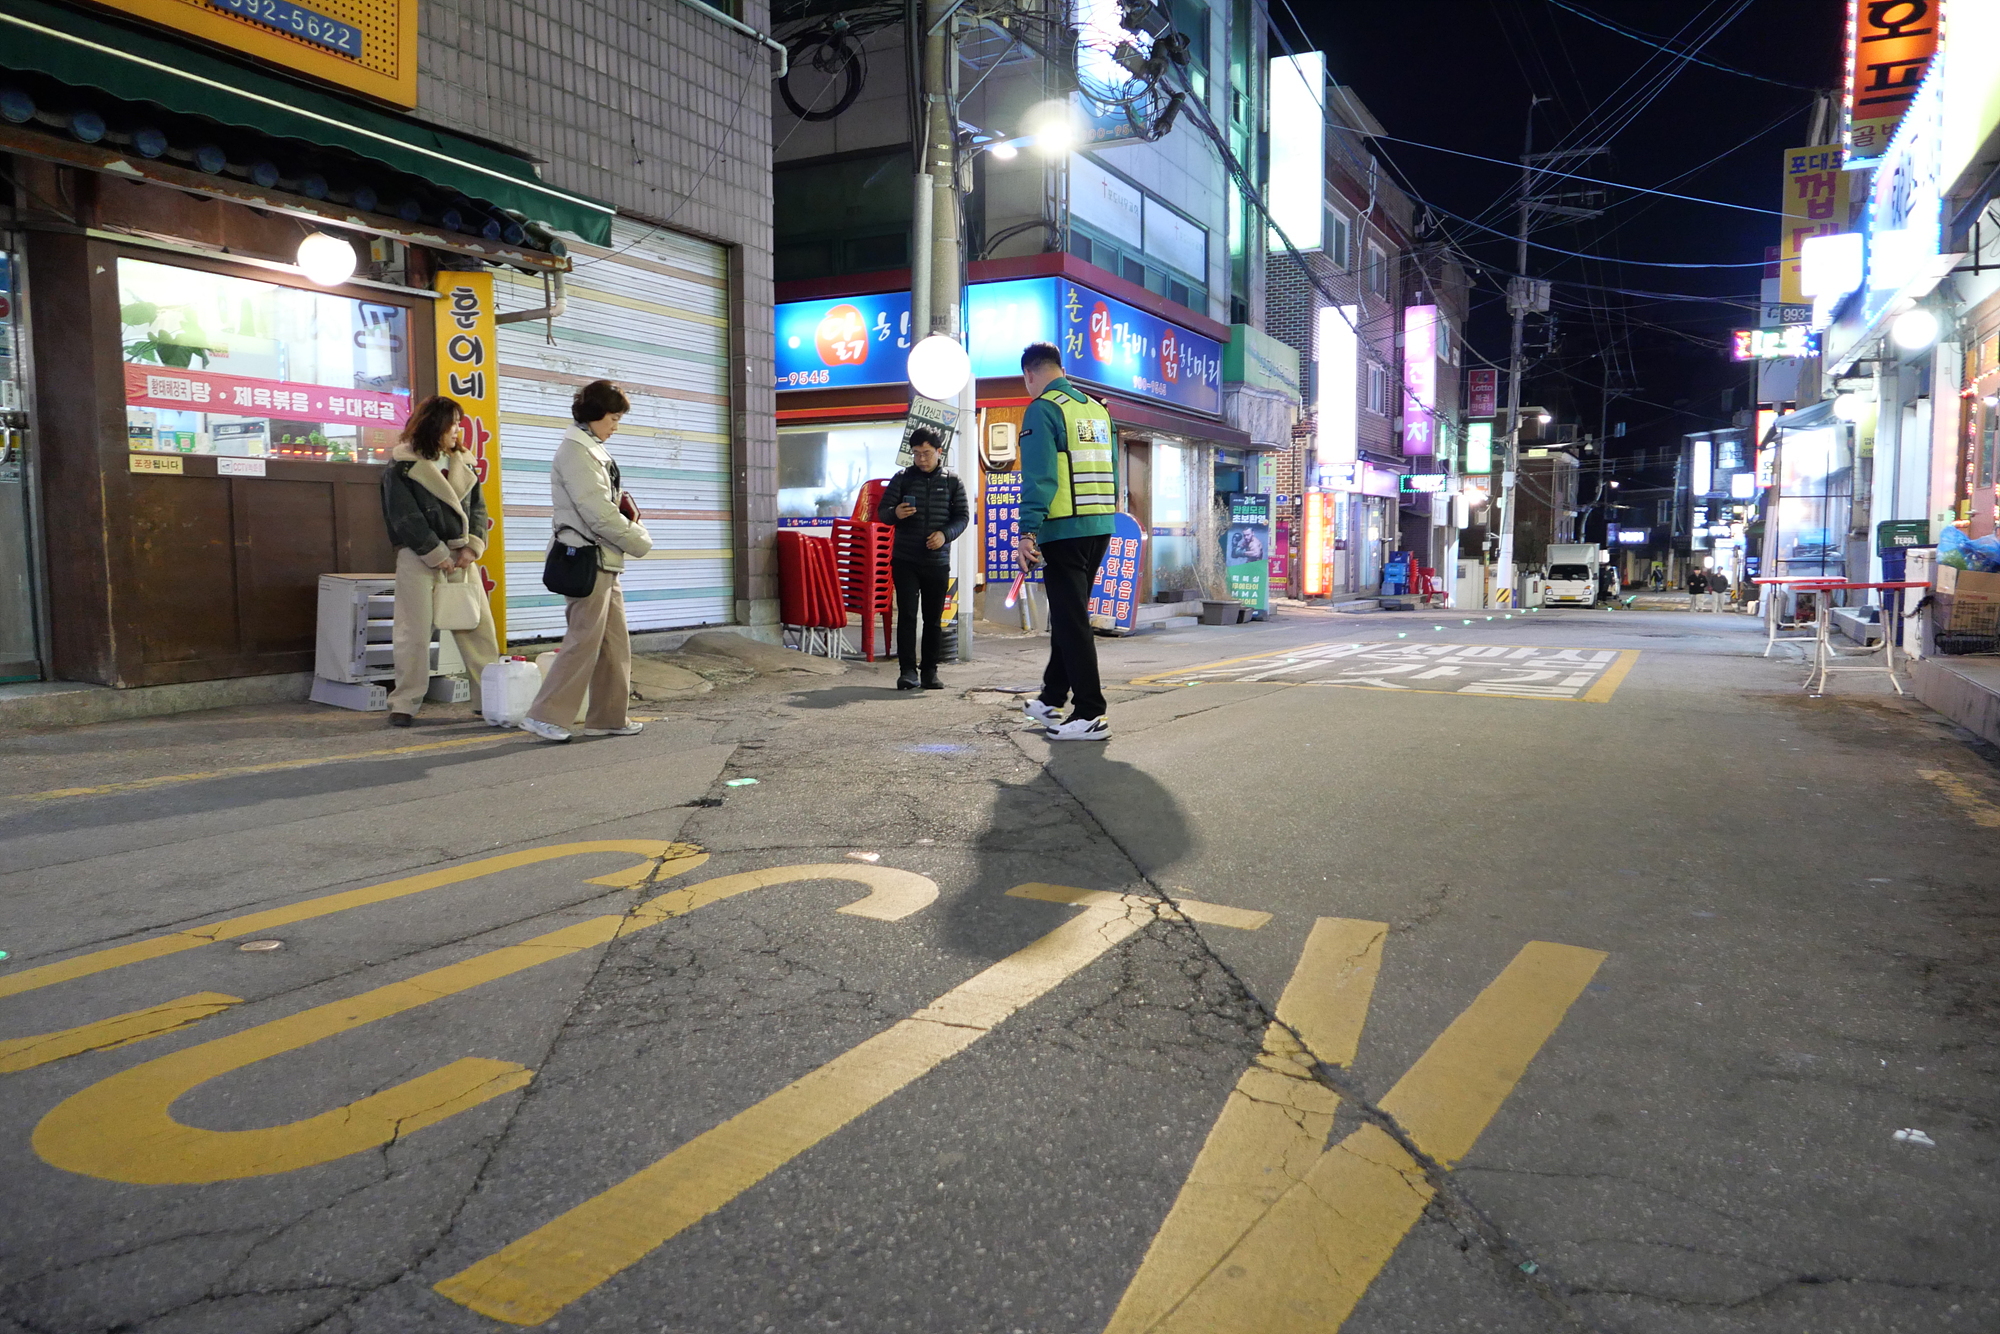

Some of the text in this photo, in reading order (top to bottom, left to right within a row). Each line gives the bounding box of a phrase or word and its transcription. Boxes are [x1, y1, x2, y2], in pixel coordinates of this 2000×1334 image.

[1064, 287, 1084, 360] 춘천
[1091, 310, 1148, 364] 닭갈비
[1162, 337, 1220, 386] 닭한마리
[151, 377, 190, 400] 황태해장국
[233, 386, 309, 413] 제육볶음
[328, 396, 395, 421] 부대전골
[1471, 384, 1493, 392] Lotto
[133, 457, 179, 470] 포장됩니다
[1232, 505, 1267, 515] 관원모집
[1893, 535, 1918, 546] TERRA
[1101, 537, 1123, 617] 닭한마리
[1115, 539, 1139, 621] 닭볶음탕
